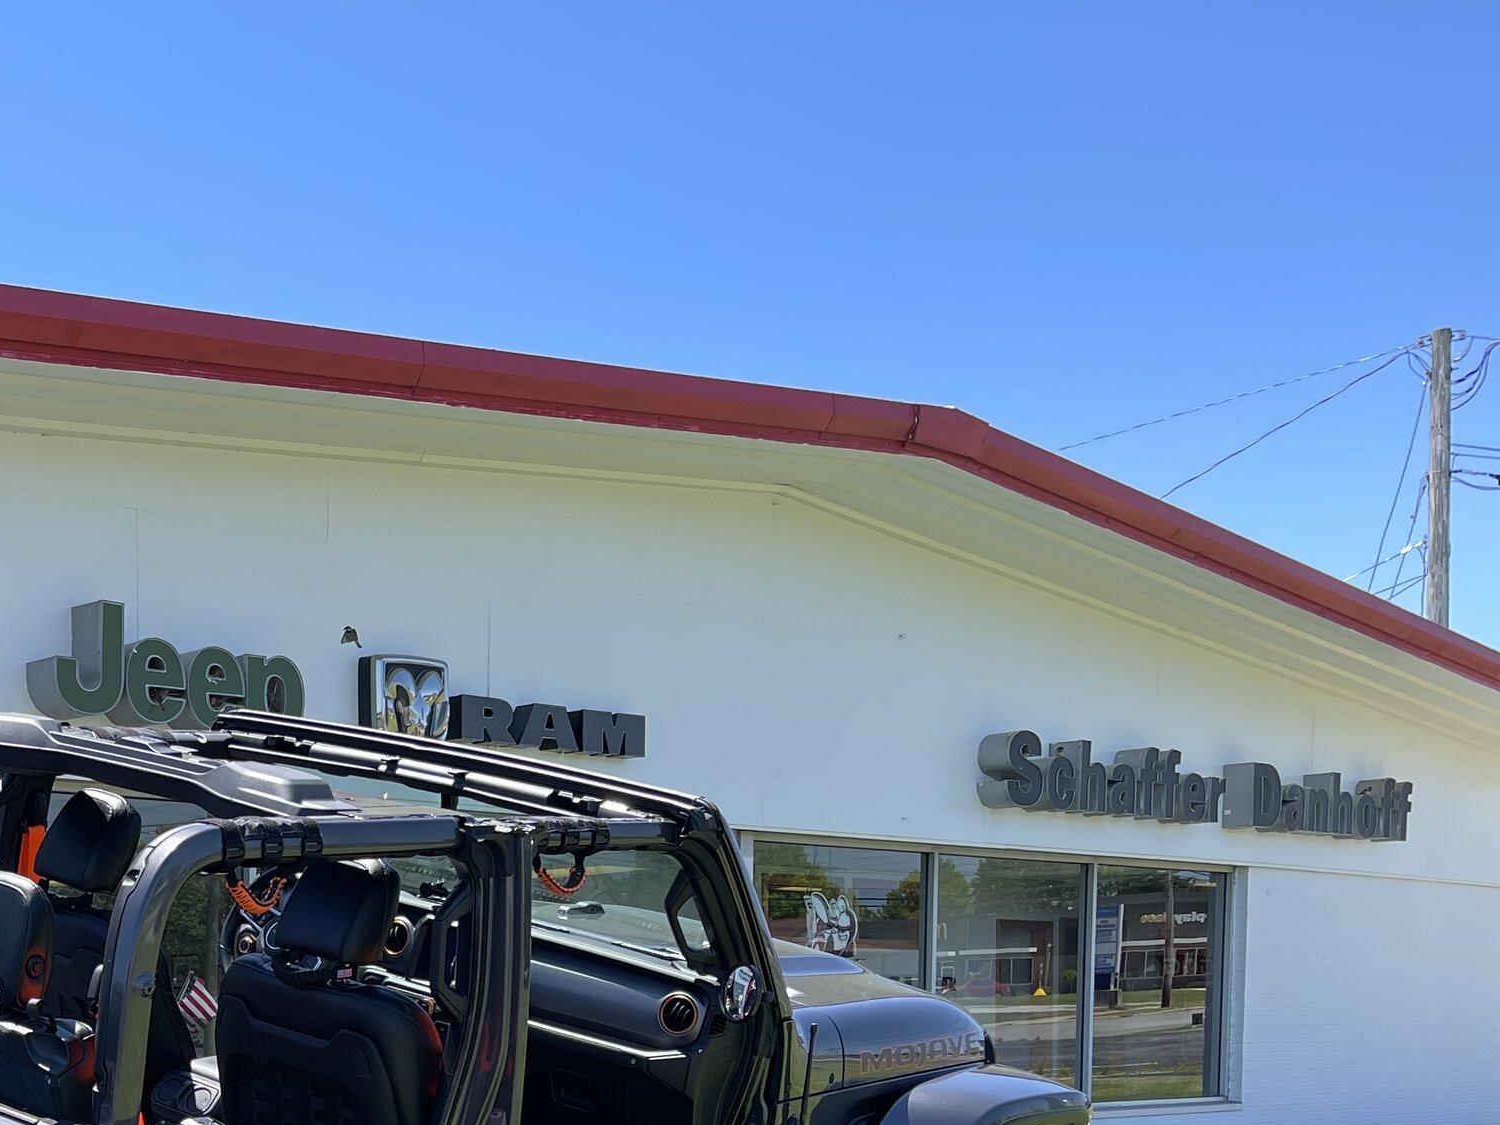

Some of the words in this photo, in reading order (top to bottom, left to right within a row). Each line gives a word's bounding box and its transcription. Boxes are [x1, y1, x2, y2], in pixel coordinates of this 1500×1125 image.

[453, 694, 646, 758] RAM
[978, 729, 1226, 824] Schaffer
[1228, 760, 1413, 842] Danhoff
[860, 1030, 983, 1075] MOJAVE
